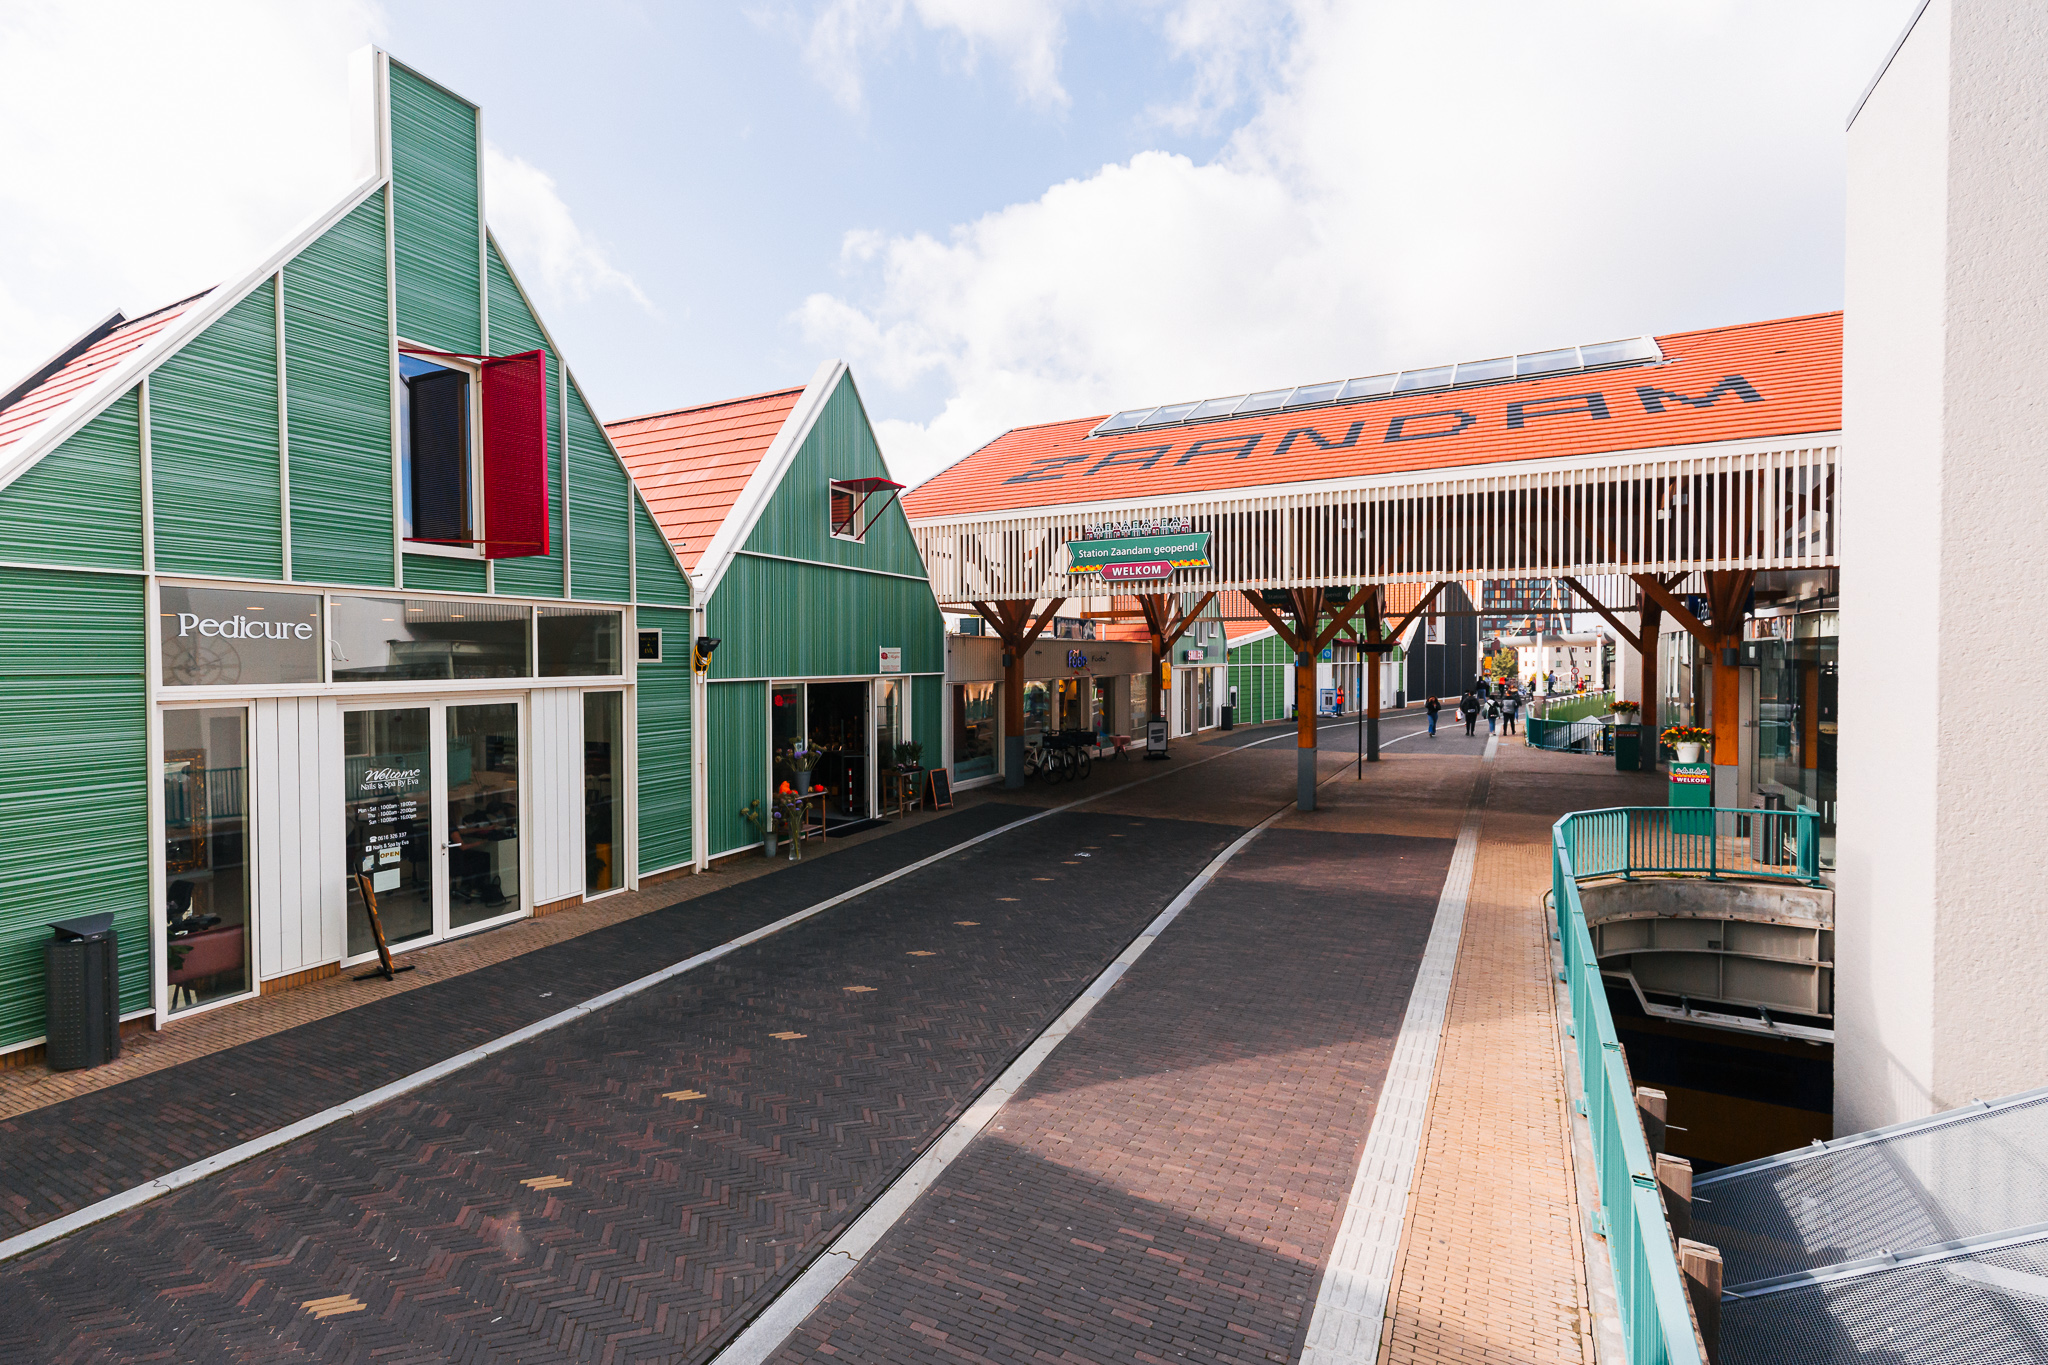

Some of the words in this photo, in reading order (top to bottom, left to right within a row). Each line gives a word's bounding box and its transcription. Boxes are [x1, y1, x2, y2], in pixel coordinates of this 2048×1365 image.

[1001, 374, 1766, 485] ZAANDAM
[1079, 548, 1108, 558] Station
[1110, 546, 1151, 556] Zaandam
[1153, 542, 1197, 555] geopend!
[1112, 565, 1161, 576] WELKOM
[177, 613, 312, 640] Pedicure
[365, 767, 420, 782] Welcome
[361, 783, 376, 791] Nails
[384, 781, 396, 789] Spa
